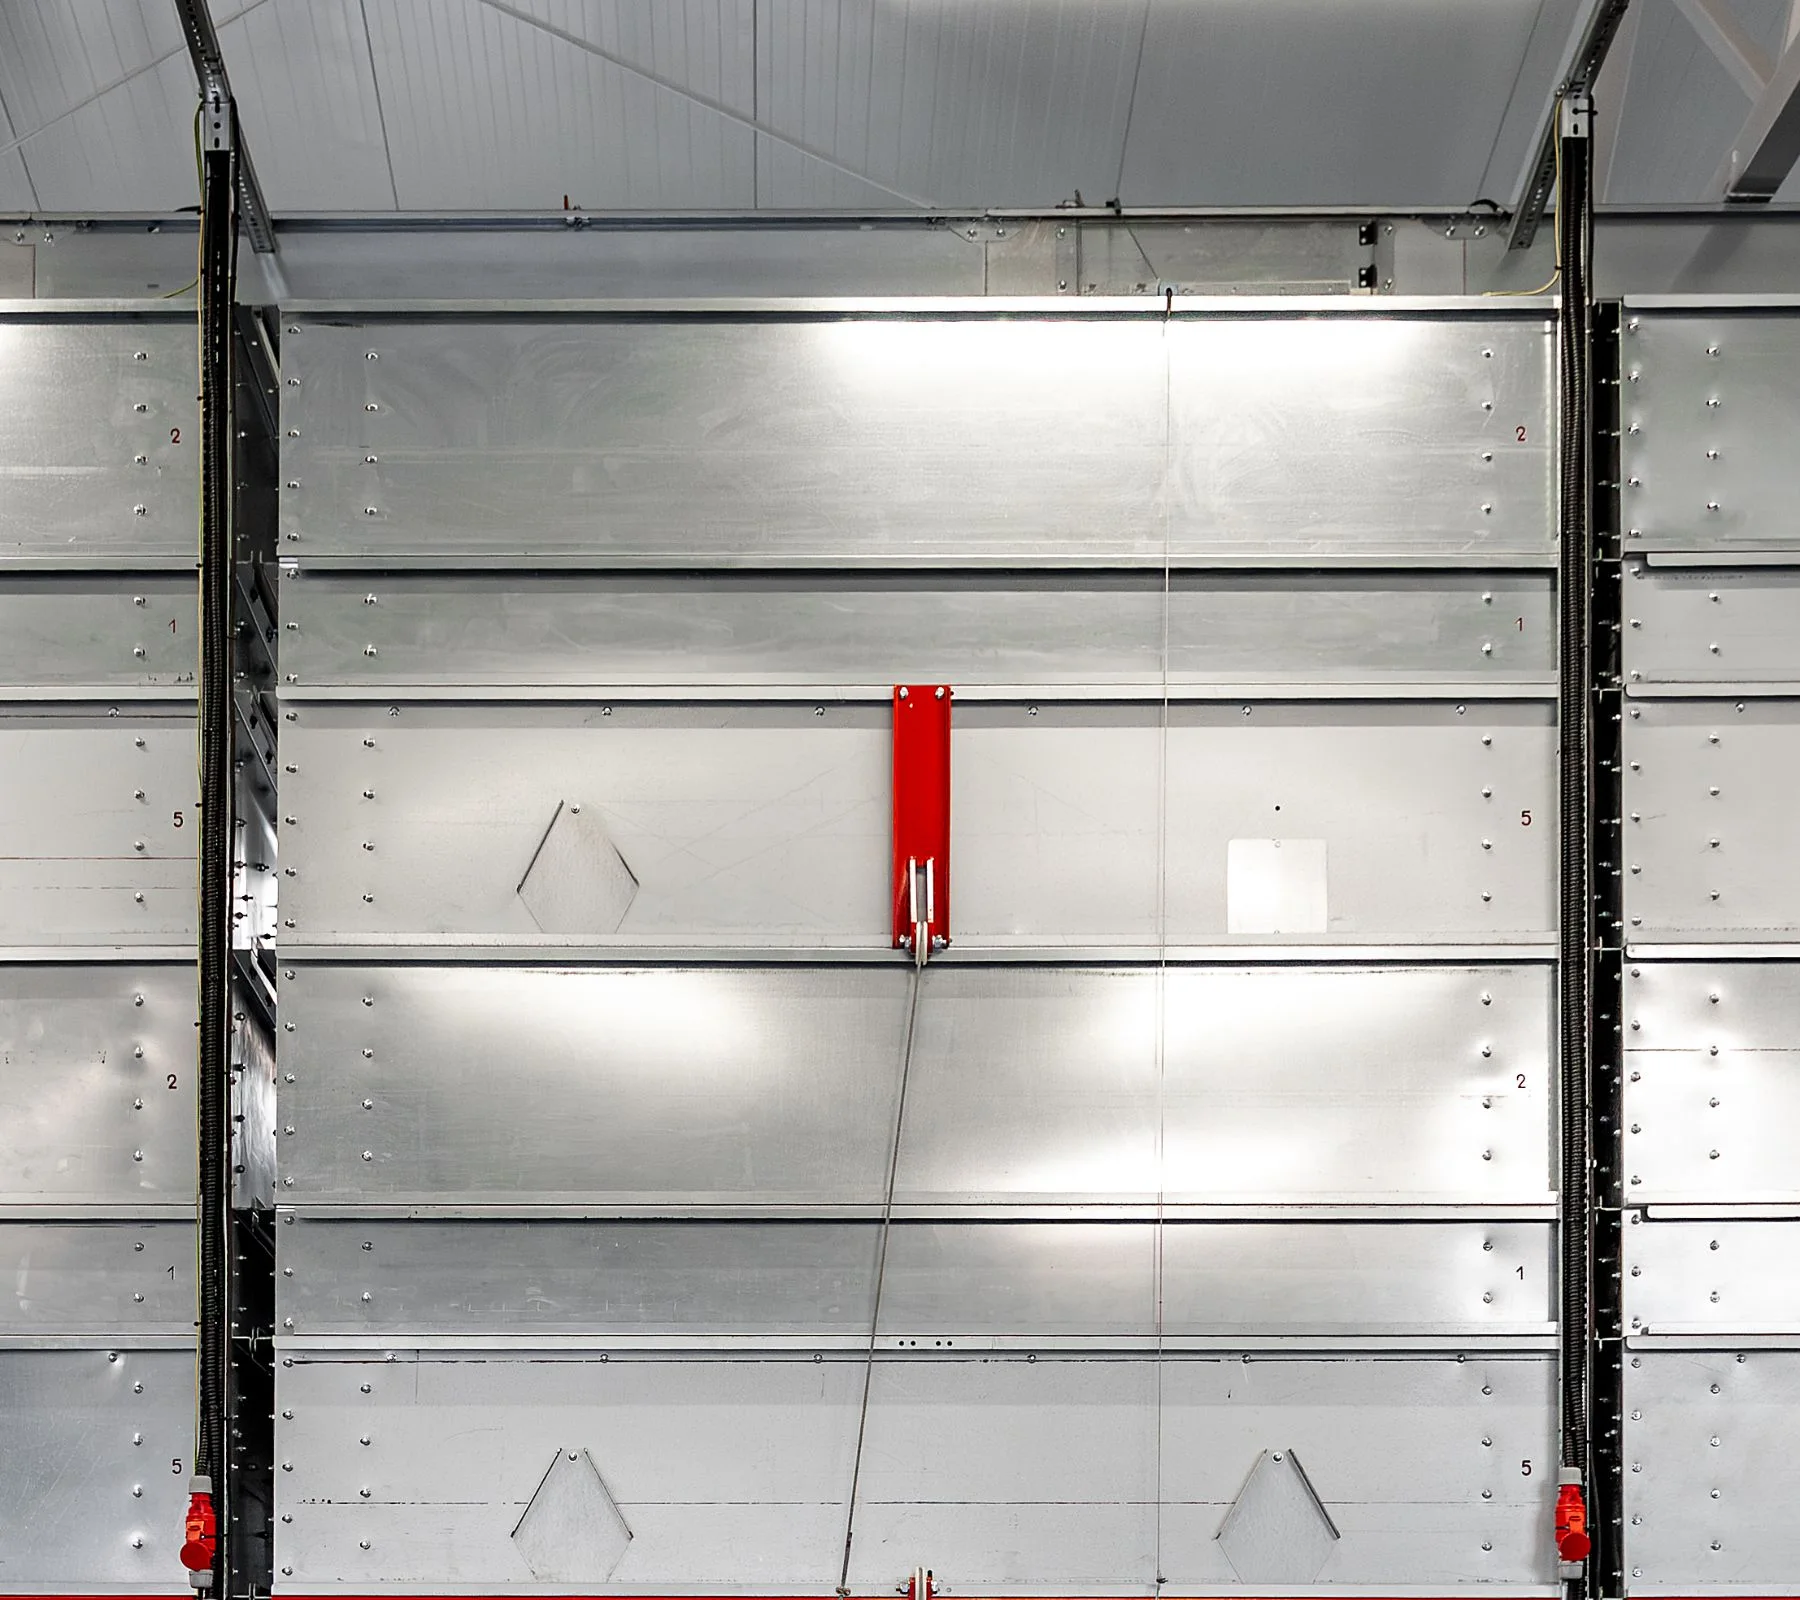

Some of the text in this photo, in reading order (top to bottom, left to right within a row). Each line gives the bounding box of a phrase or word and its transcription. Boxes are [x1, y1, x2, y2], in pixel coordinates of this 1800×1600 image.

[170, 427, 181, 444] 2
[1515, 425, 1526, 442] 2
[168, 619, 176, 634] 1
[1515, 617, 1523, 632] 1
[173, 811, 184, 828] 5
[1521, 810, 1532, 826] 5
[166, 1073, 178, 1090] 2
[1516, 1073, 1526, 1089] 2
[167, 1265, 175, 1280] 1
[1516, 1265, 1524, 1280] 1
[172, 1458, 182, 1475] 5
[1521, 1459, 1532, 1476] 5
